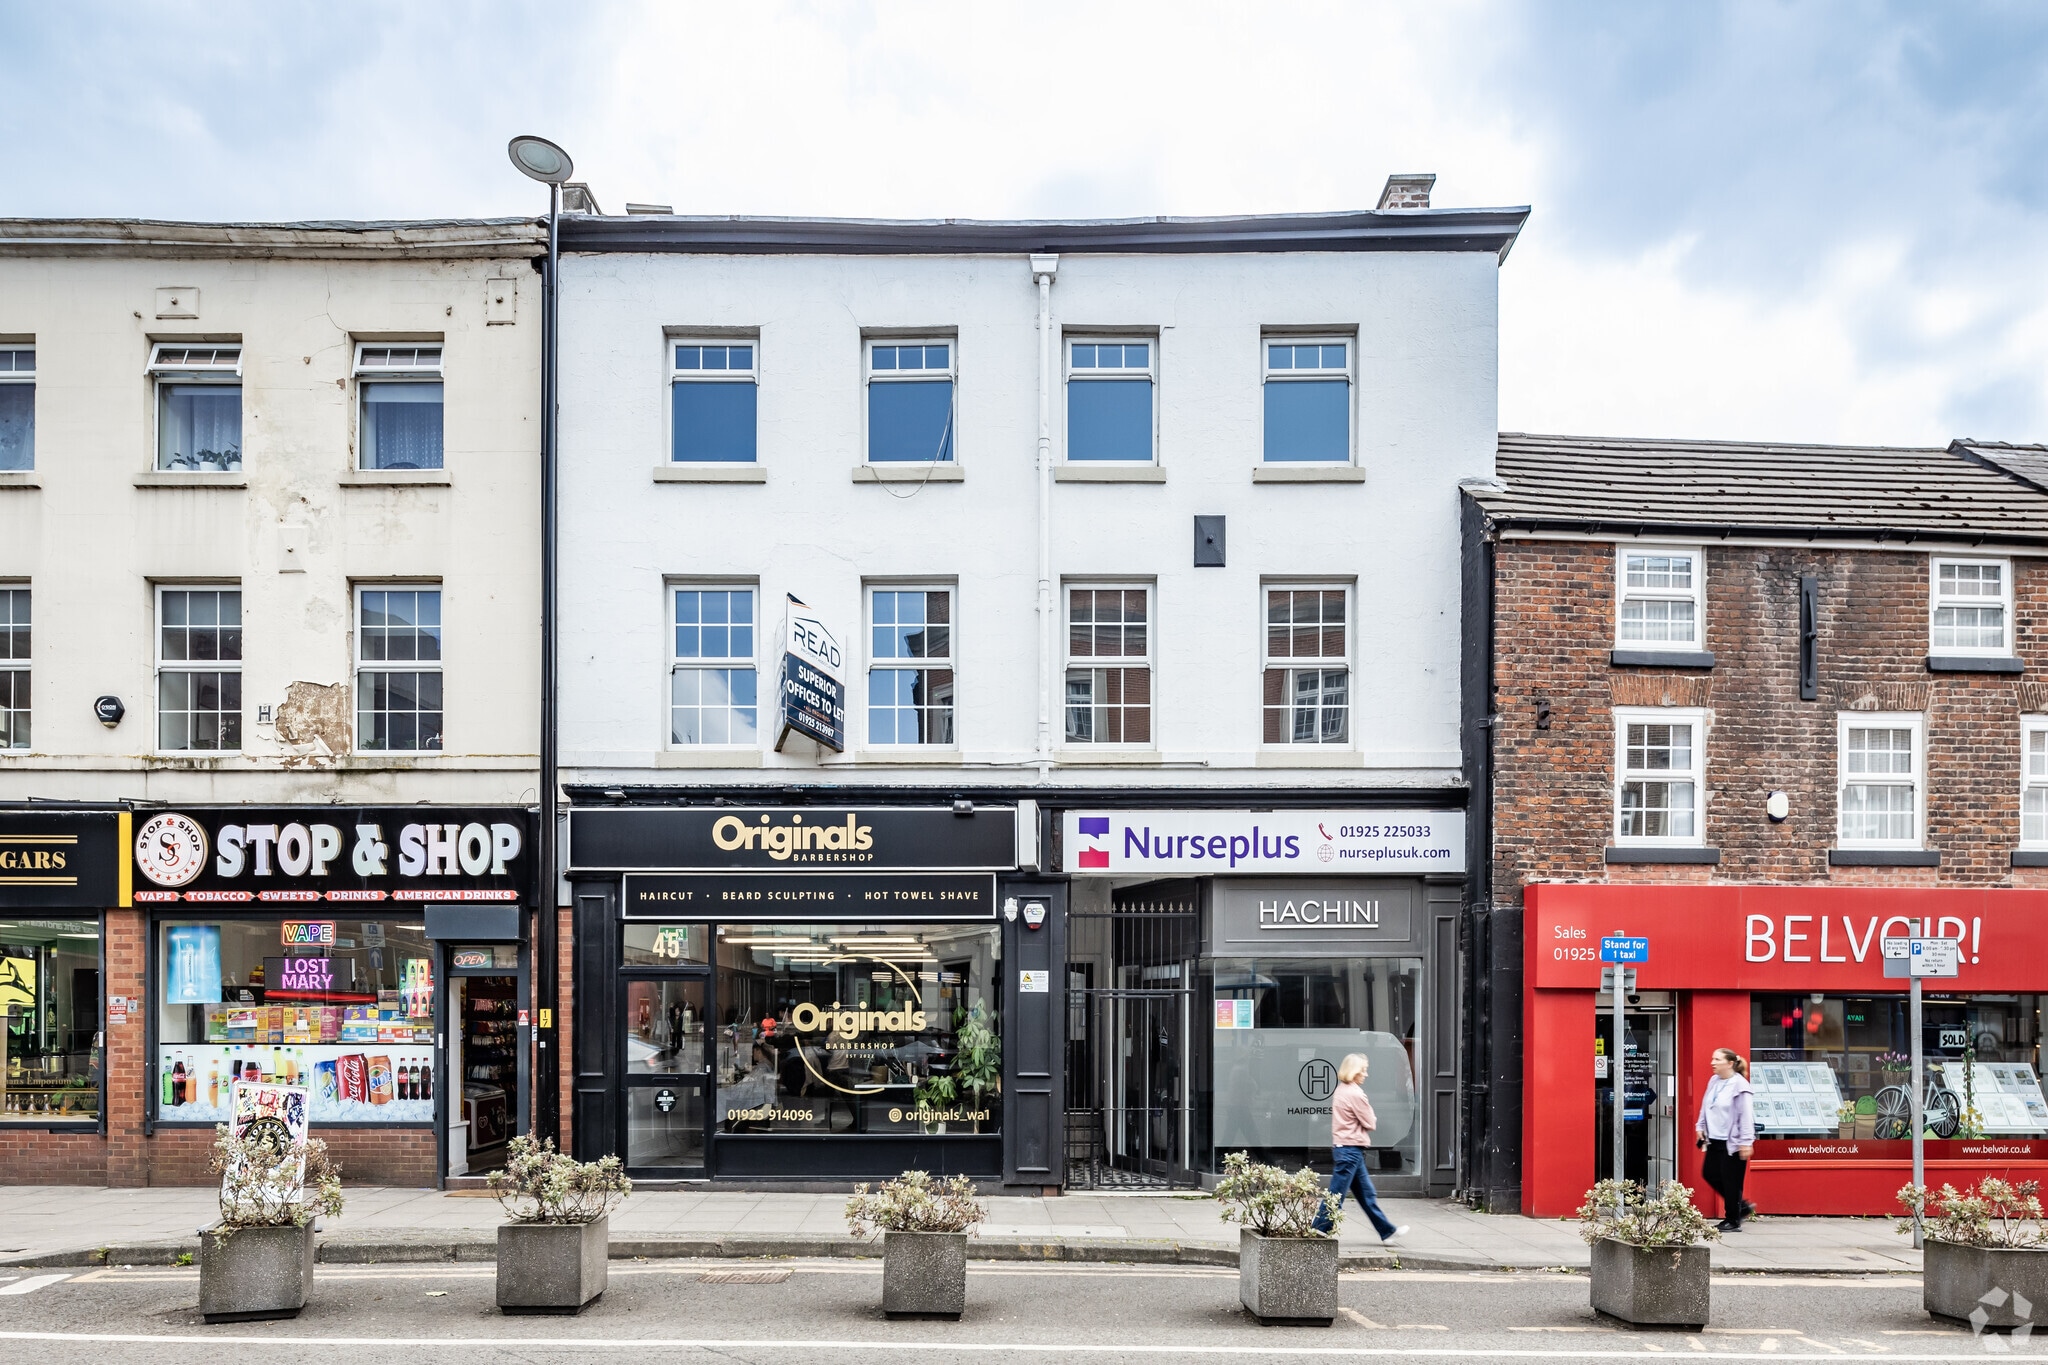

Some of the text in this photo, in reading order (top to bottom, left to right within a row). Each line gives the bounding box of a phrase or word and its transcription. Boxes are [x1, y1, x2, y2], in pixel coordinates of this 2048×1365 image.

[795, 622, 841, 668] READ
[798, 665, 837, 699] SUPERIOR
[787, 680, 845, 722] OFFICES TO LET
[140, 818, 200, 852] STOP & SHOP
[712, 813, 874, 861] Originals
[1340, 825, 1431, 838] 01925 225033
[217, 822, 523, 877] STOP & SHOP
[1124, 826, 1301, 868] Nurseplus
[1339, 846, 1451, 861] nurseplusuk.com
[793, 853, 874, 862] BARBERSHOP
[140, 892, 172, 901] VAPE
[188, 892, 247, 901] TOBACCO
[262, 892, 314, 900] SWEETS
[331, 891, 379, 900] DRINKS
[395, 890, 511, 900] AMERICAN DRINKS
[640, 891, 694, 900] HAIRCUT
[722, 891, 835, 901] BEARD SCULPTING
[864, 891, 979, 900] HOT TOWEL SHAVE
[1260, 900, 1379, 924] HACHINI
[284, 924, 334, 943] VAPE
[1554, 925, 1587, 939] Sales
[652, 931, 680, 958] 45
[1604, 940, 1646, 949] Stand for
[453, 955, 486, 966] OPEN
[1553, 947, 1596, 961] 01925
[1613, 950, 1618, 959] 1
[1619, 950, 1637, 959] taxi
[284, 958, 330, 974] LOST
[281, 974, 334, 990] MARY
[792, 1000, 927, 1040] Originals
[825, 1042, 896, 1051] BARBERSHOP
[1941, 1034, 1966, 1046] SOLD
[728, 1109, 813, 1121] 01925 914096
[905, 1108, 990, 1124] originals_wa1
[1788, 1144, 1859, 1154] www.belvoir.co.uk
[1962, 1144, 2031, 1154] www.belvoir.co.uk
